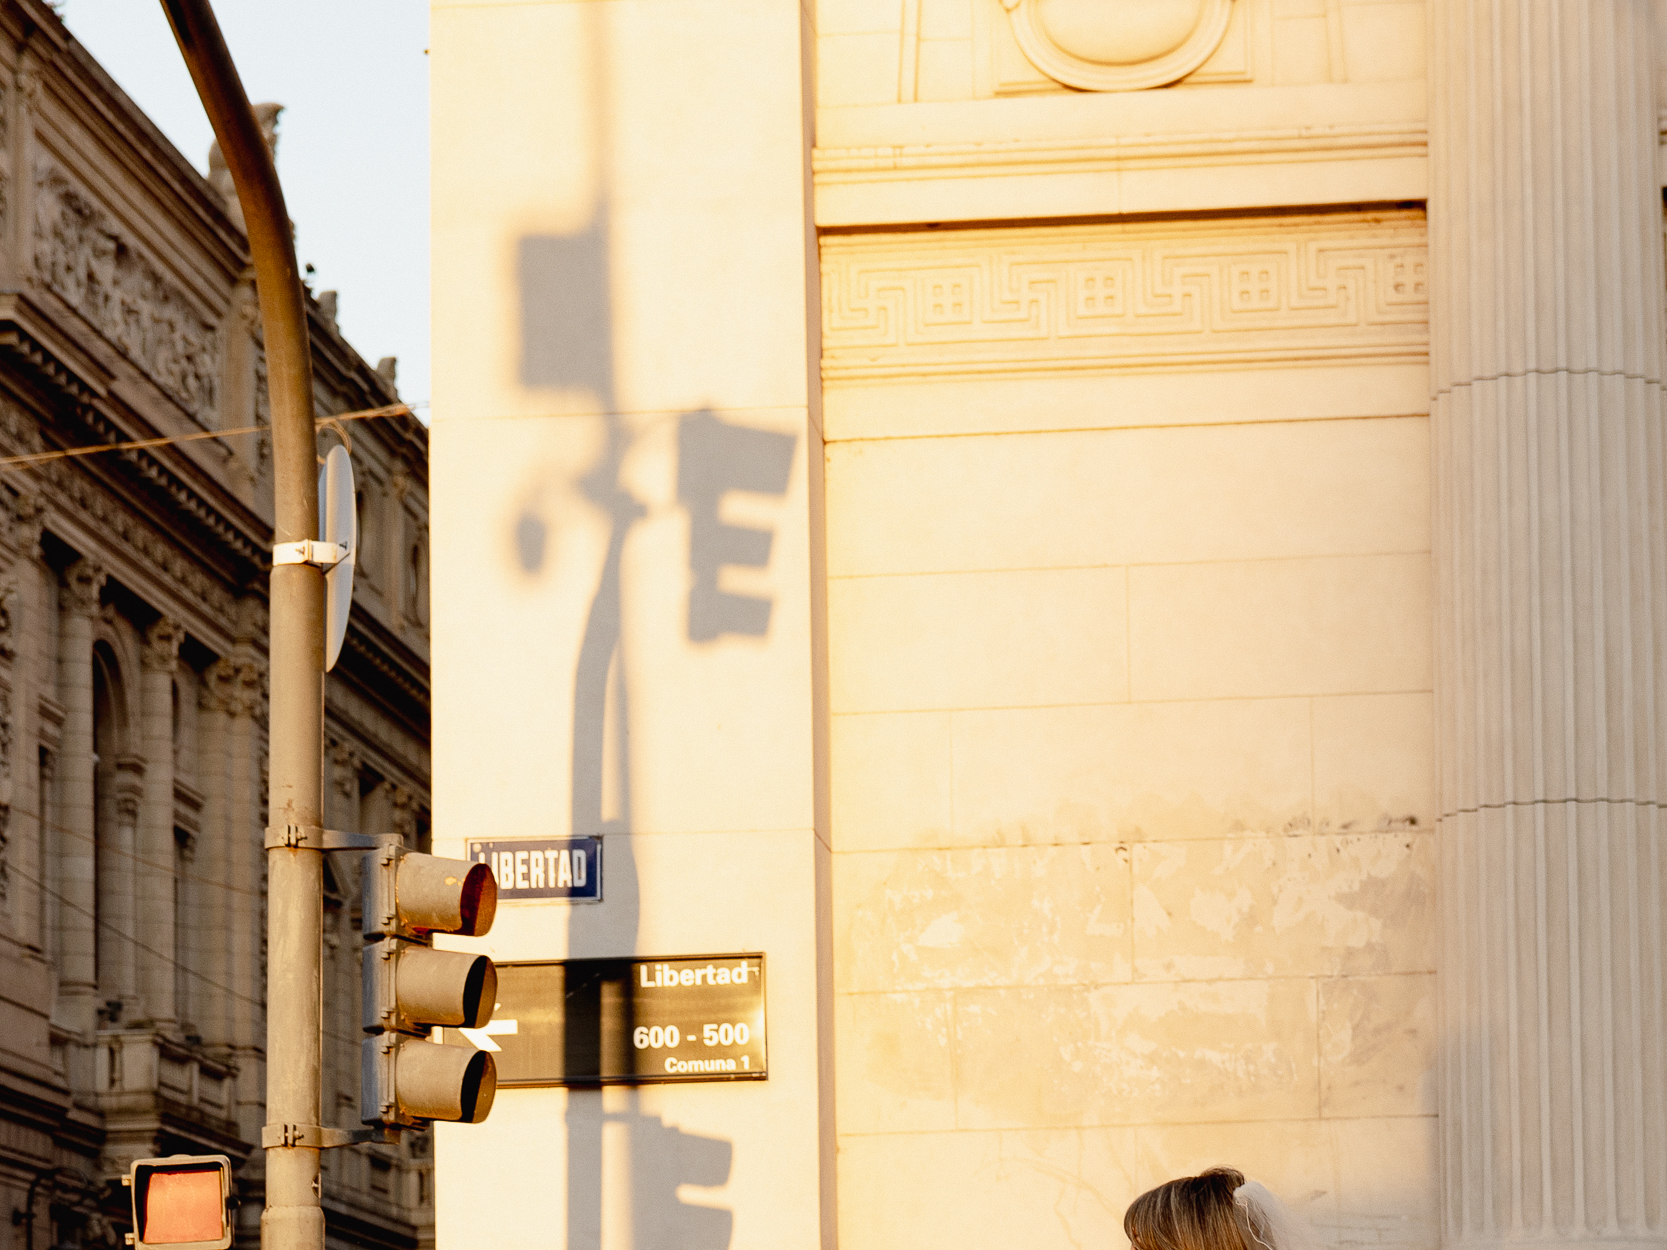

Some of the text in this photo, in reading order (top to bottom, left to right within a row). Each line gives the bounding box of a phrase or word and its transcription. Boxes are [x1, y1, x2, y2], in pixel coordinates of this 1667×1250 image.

[478, 849, 587, 890] IBERTAD
[640, 961, 749, 988] Libertad
[633, 1025, 680, 1049] 600
[702, 1022, 750, 1047] 500
[664, 1054, 750, 1074] Comuna 1
